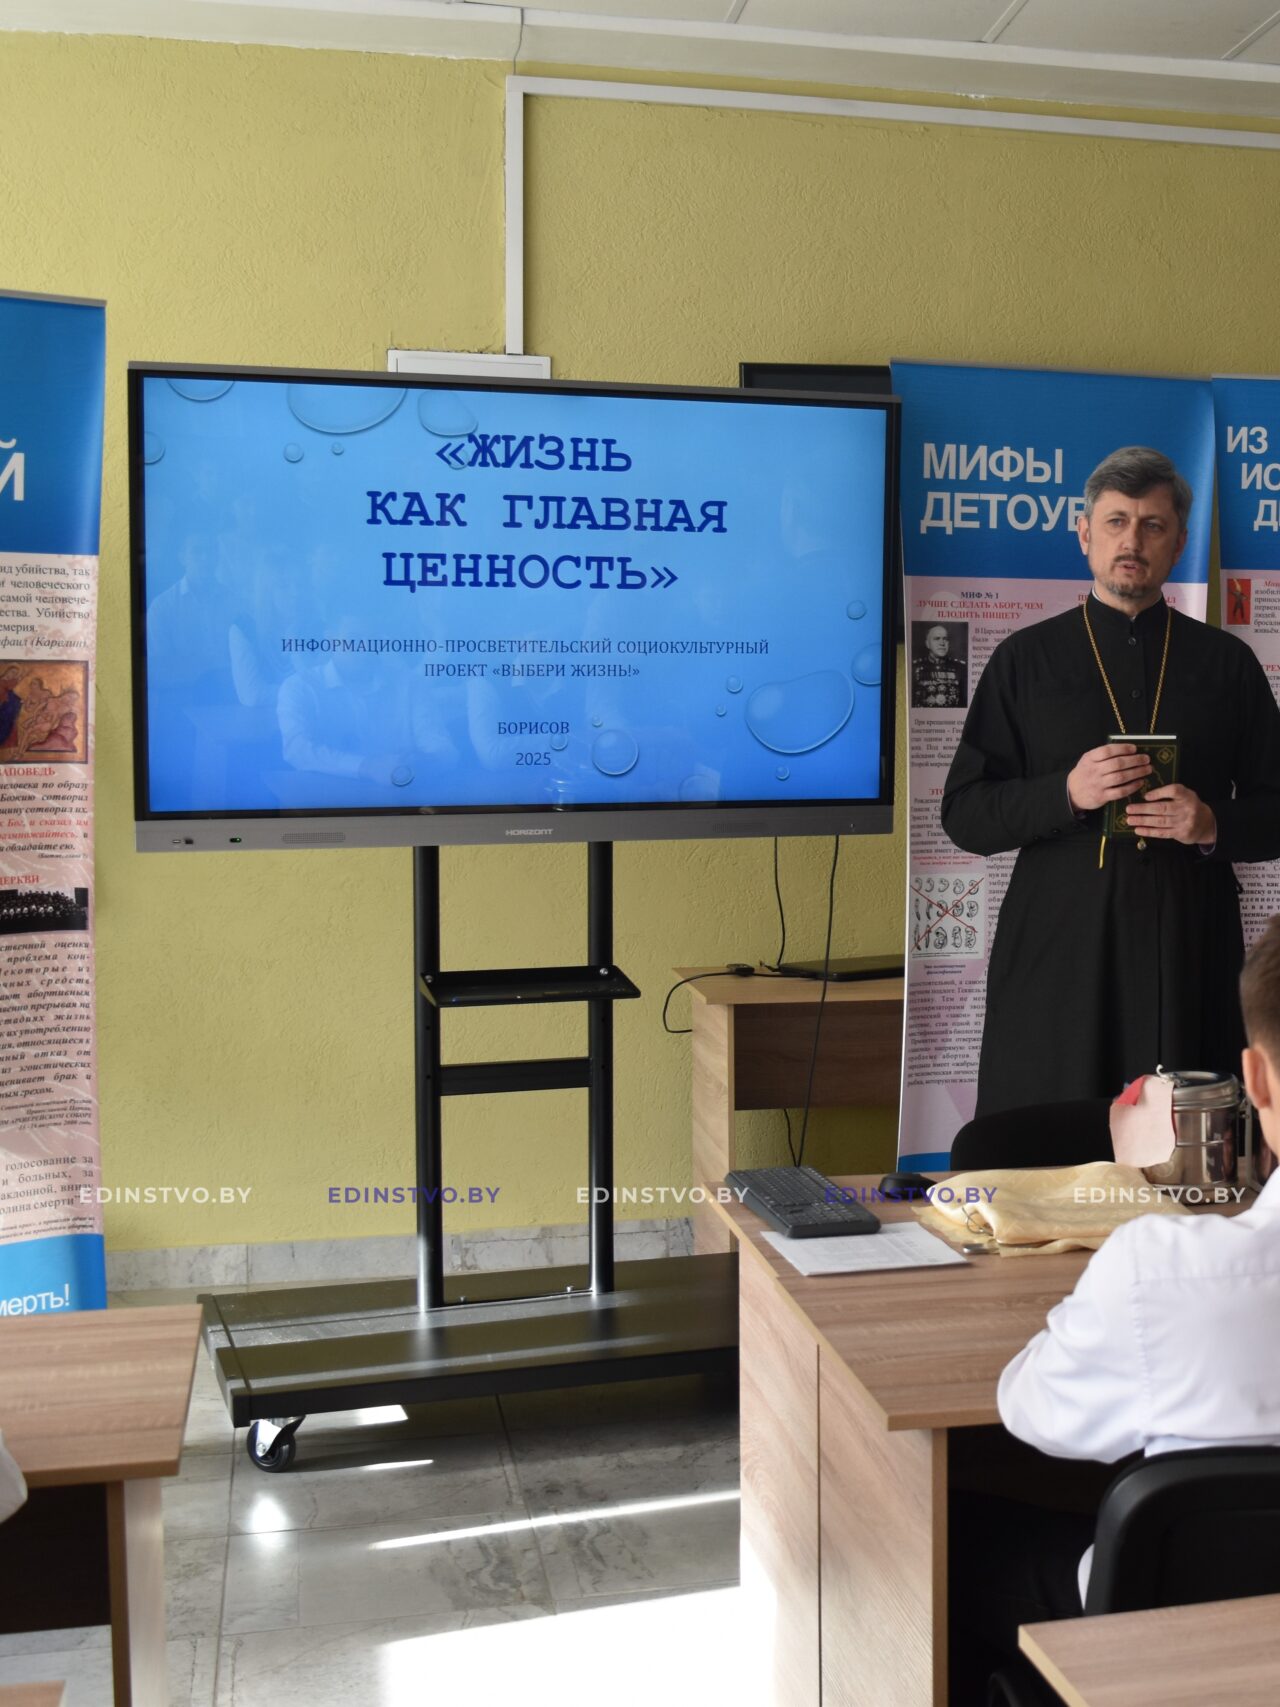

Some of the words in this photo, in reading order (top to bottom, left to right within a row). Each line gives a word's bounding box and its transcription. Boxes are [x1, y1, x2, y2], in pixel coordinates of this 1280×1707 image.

[1227, 426, 1269, 455] ИЗ
[435, 432, 633, 473] «ЖИЗНЬ
[922, 442, 1063, 484] МИФЫ
[365, 489, 467, 527] КАК
[502, 492, 728, 533] ГЛАВНАЯ
[15, 563, 69, 576] убийства,
[73, 568, 90, 576] так
[382, 550, 679, 593] ЦЕННОСТЬ»
[10, 580, 90, 590] человеческого
[1, 593, 32, 603] самой
[35, 595, 89, 605] человече-
[961, 591, 983, 600] МИФ
[916, 600, 949, 609] ЛУЧШЕ
[950, 601, 991, 609] СДЕЛАТЬ
[992, 602, 1022, 610] АБОРТ,
[1023, 602, 1044, 610] ЧЕМ
[36, 608, 90, 619] Убийство
[937, 611, 980, 619] ПЛОДИТЬ
[982, 611, 1022, 620] НИЩЕТУ
[281, 636, 613, 657] ИНФОРМАЦИОННО-ПРОСВЕТИТЕЛЬСКИЙ
[617, 636, 770, 656] СОЦИОКУЛЬТУРНЫЙ
[424, 662, 488, 678] ПРОЕКТ
[492, 662, 566, 678] «ВЫБЕРИ
[570, 663, 640, 679] ЖИЗНЬ!»
[497, 721, 570, 736] БОРИСОВ
[515, 751, 551, 767] 2025
[5, 1156, 77, 1172] голосование
[82, 1156, 94, 1164] за
[18, 1170, 72, 1184] больных,
[82, 1169, 94, 1178] за
